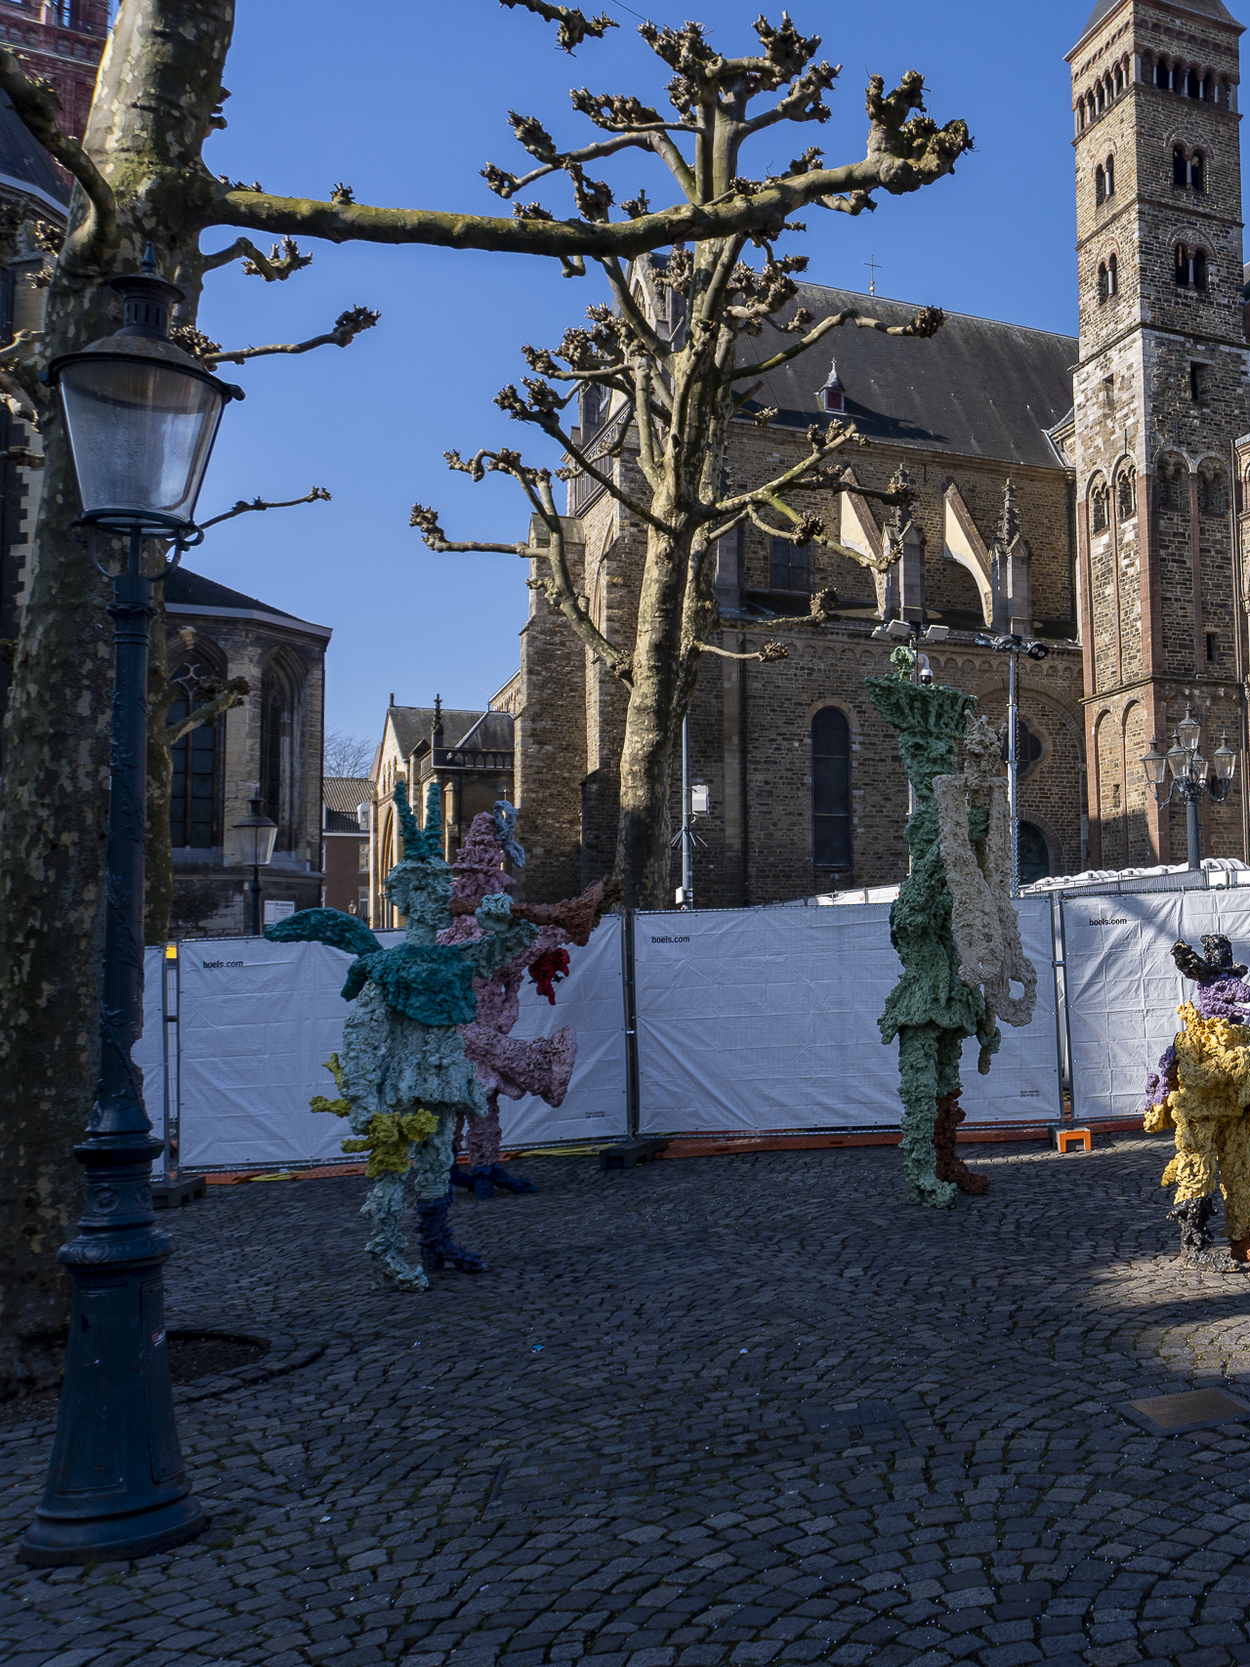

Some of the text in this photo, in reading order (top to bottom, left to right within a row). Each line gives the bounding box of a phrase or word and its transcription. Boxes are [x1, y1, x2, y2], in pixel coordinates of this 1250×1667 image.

[1089, 918, 1127, 926] boels.com
[651, 936, 690, 944] boels.com
[202, 961, 244, 969] boels.com
